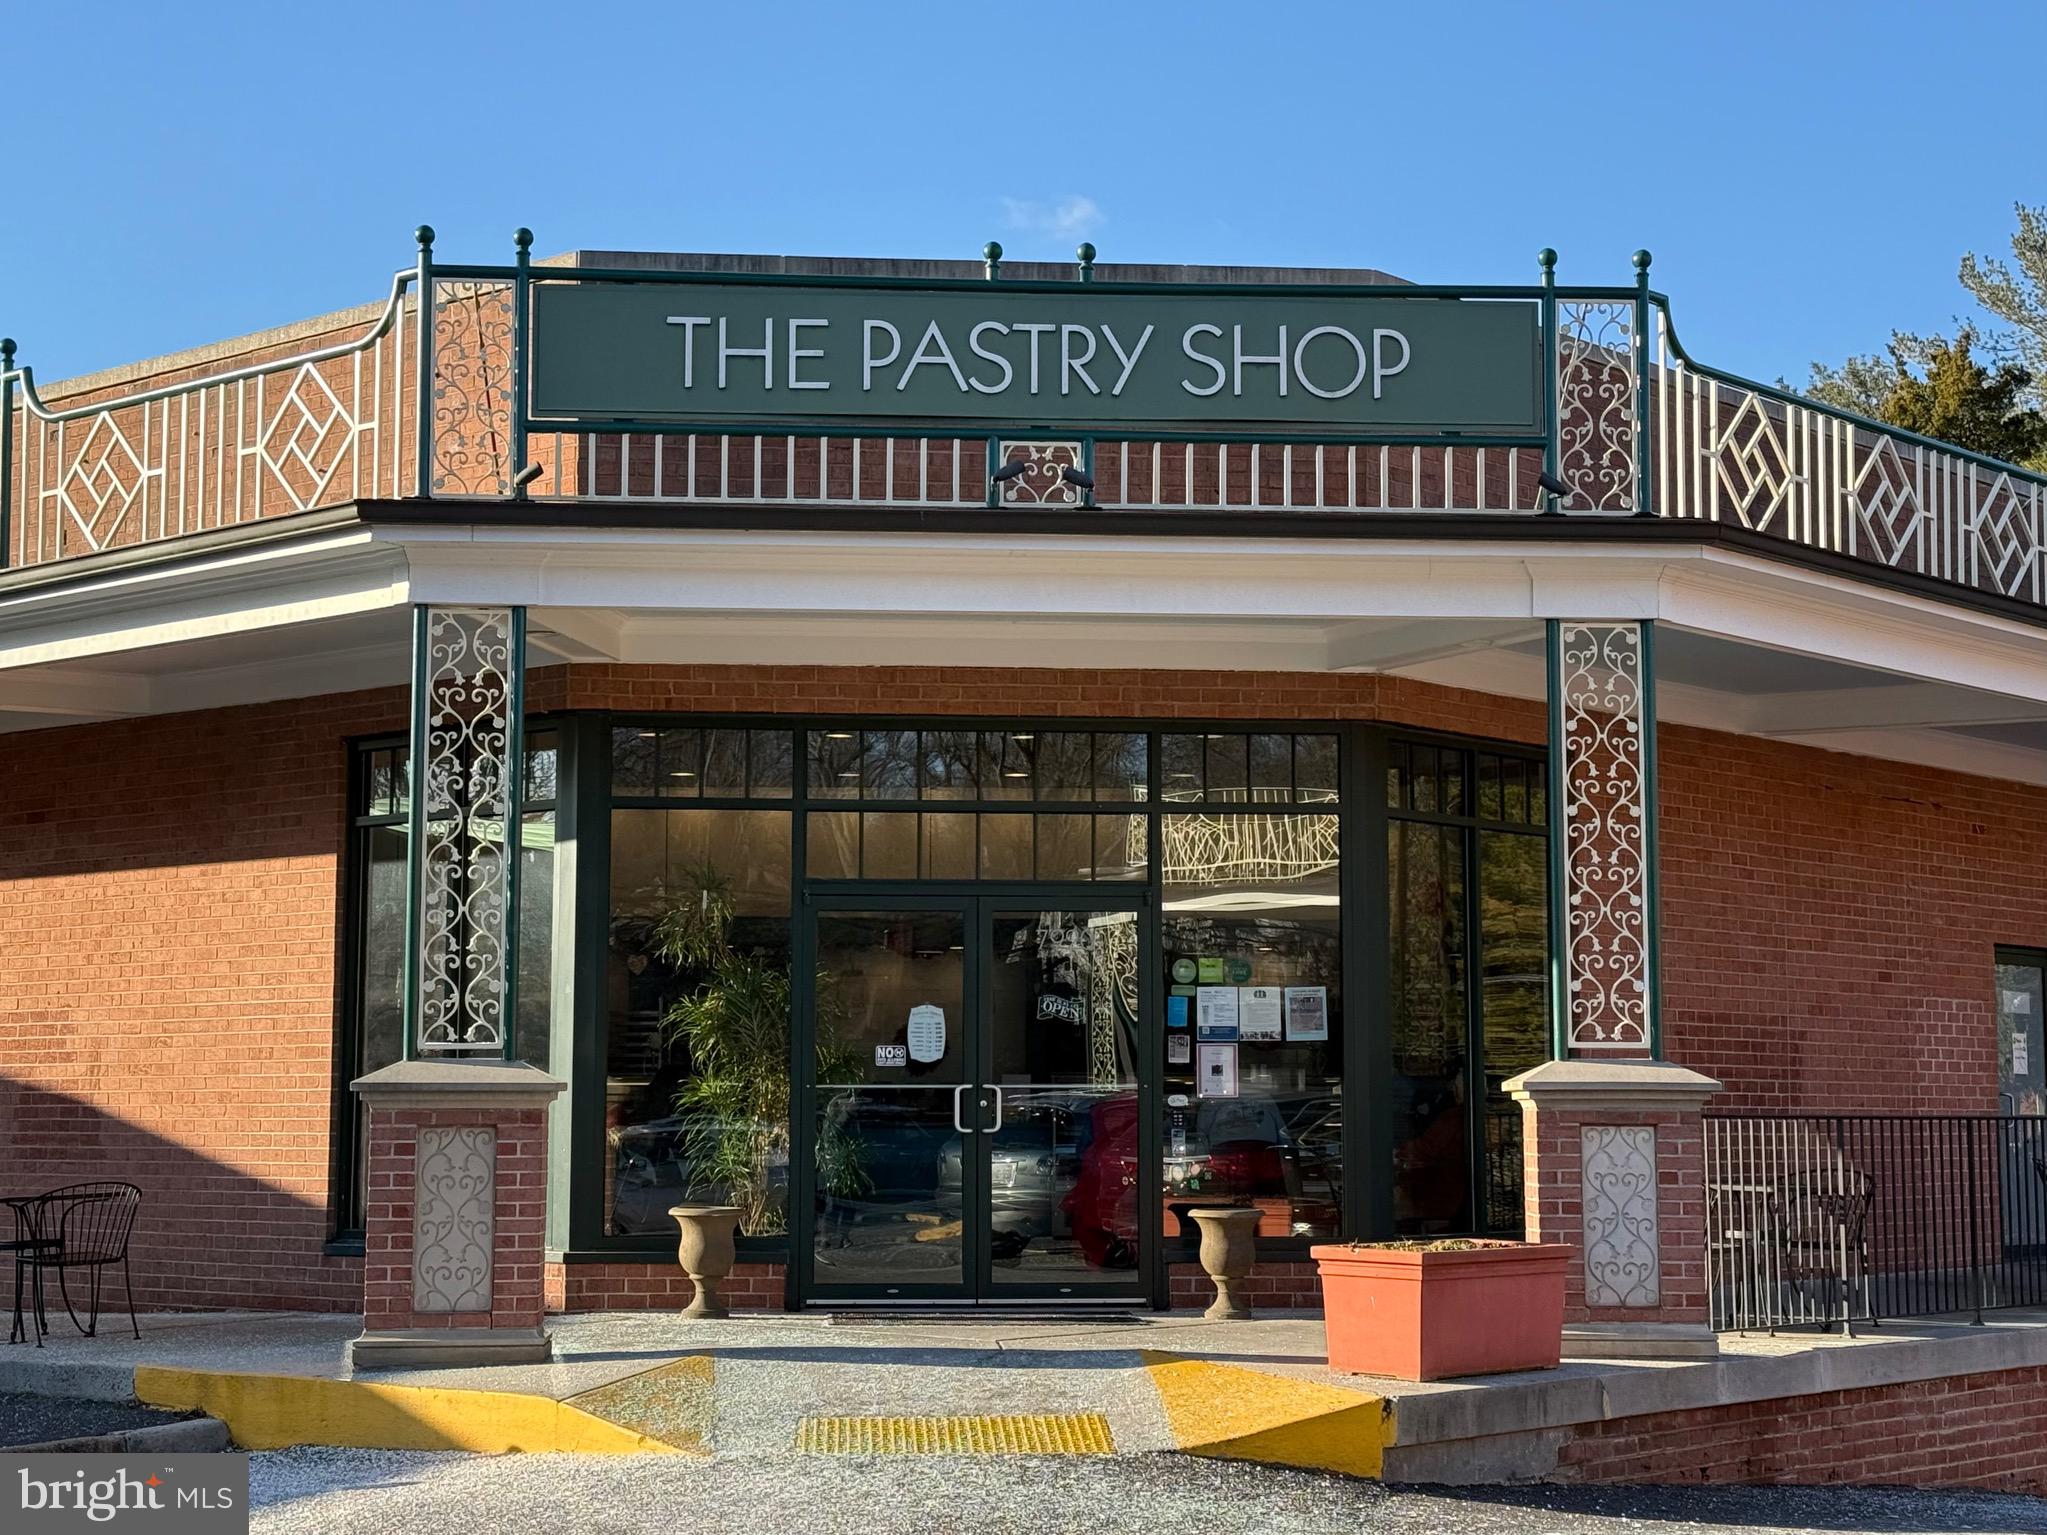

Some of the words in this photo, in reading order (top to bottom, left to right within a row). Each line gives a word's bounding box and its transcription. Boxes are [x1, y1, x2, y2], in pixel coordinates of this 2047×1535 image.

[666, 314, 831, 390] THE
[862, 319, 1155, 396] PASTRY
[1180, 324, 1412, 400] SHOP
[1042, 1000, 1080, 1019] OPEN
[878, 1047, 895, 1058] NO
